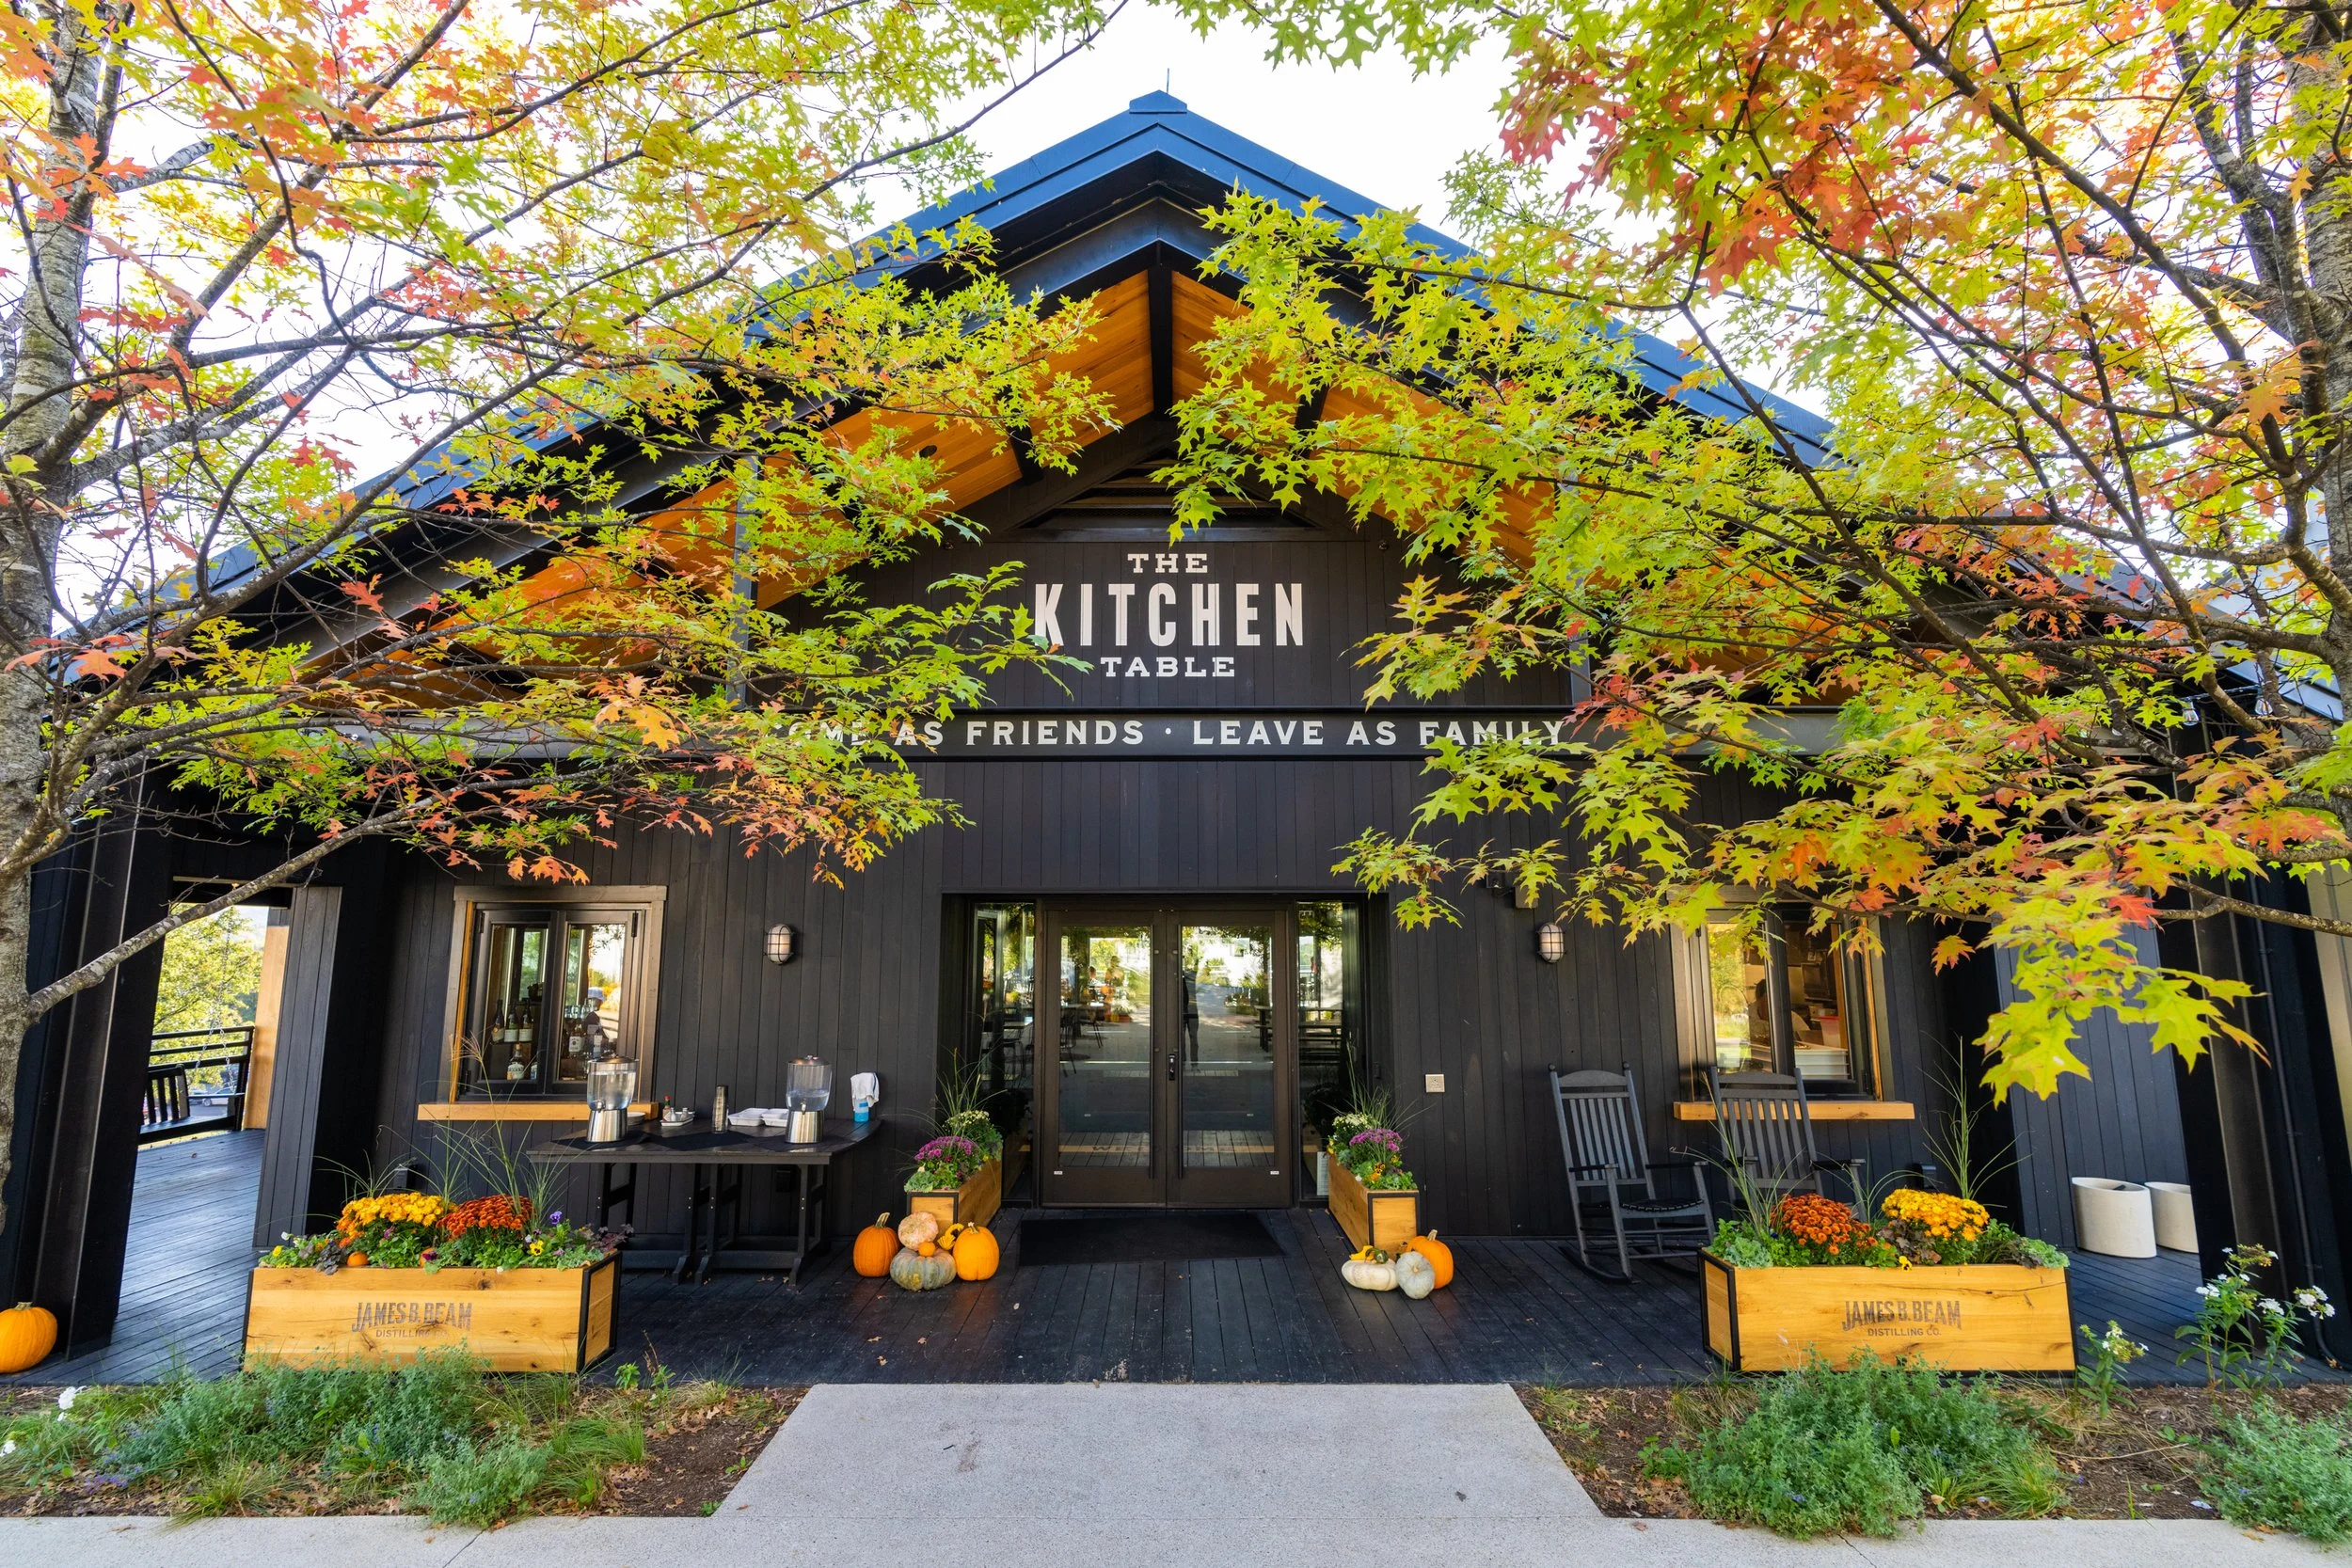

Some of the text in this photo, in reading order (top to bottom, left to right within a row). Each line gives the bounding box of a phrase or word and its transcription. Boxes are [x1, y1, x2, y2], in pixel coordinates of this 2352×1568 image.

[1127, 553, 1208, 574] THE
[1034, 582, 1304, 647] KITCHEN
[1100, 657, 1235, 677] TABLE
[895, 721, 944, 746] AS
[965, 720, 1144, 746] FRIENDS
[1193, 721, 1324, 745] LEAVE
[1345, 721, 1397, 746] AS
[1419, 721, 1565, 747] FAMILY
[351, 1302, 472, 1332] JAMES B. BEAM
[1842, 1301, 1962, 1331] JAMES B. BEAM
[1867, 1328, 1942, 1337] DISTILLING CO.
